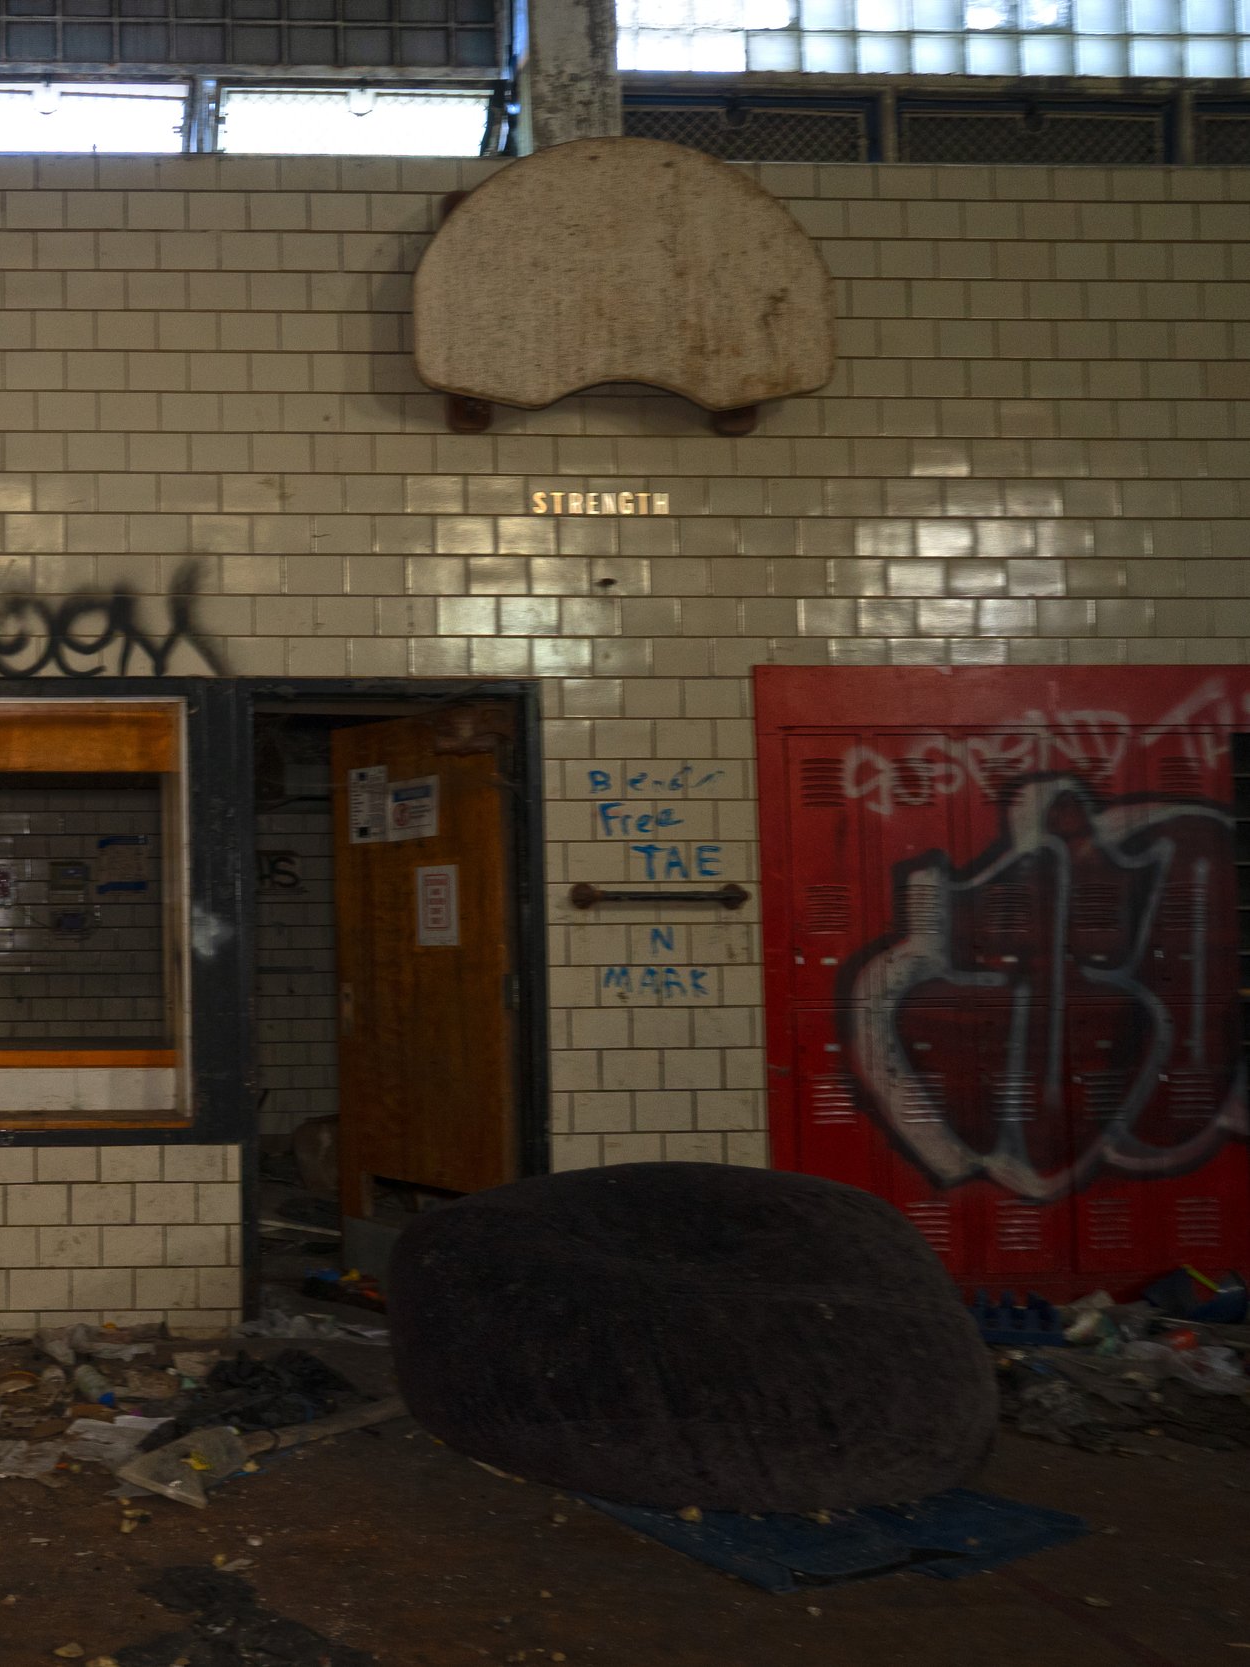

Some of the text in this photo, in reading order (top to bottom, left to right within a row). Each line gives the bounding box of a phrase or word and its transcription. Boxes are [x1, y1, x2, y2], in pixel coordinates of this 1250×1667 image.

[532, 491, 670, 515] STRENGTH
[631, 844, 723, 880] TAE
[651, 926, 675, 955] N
